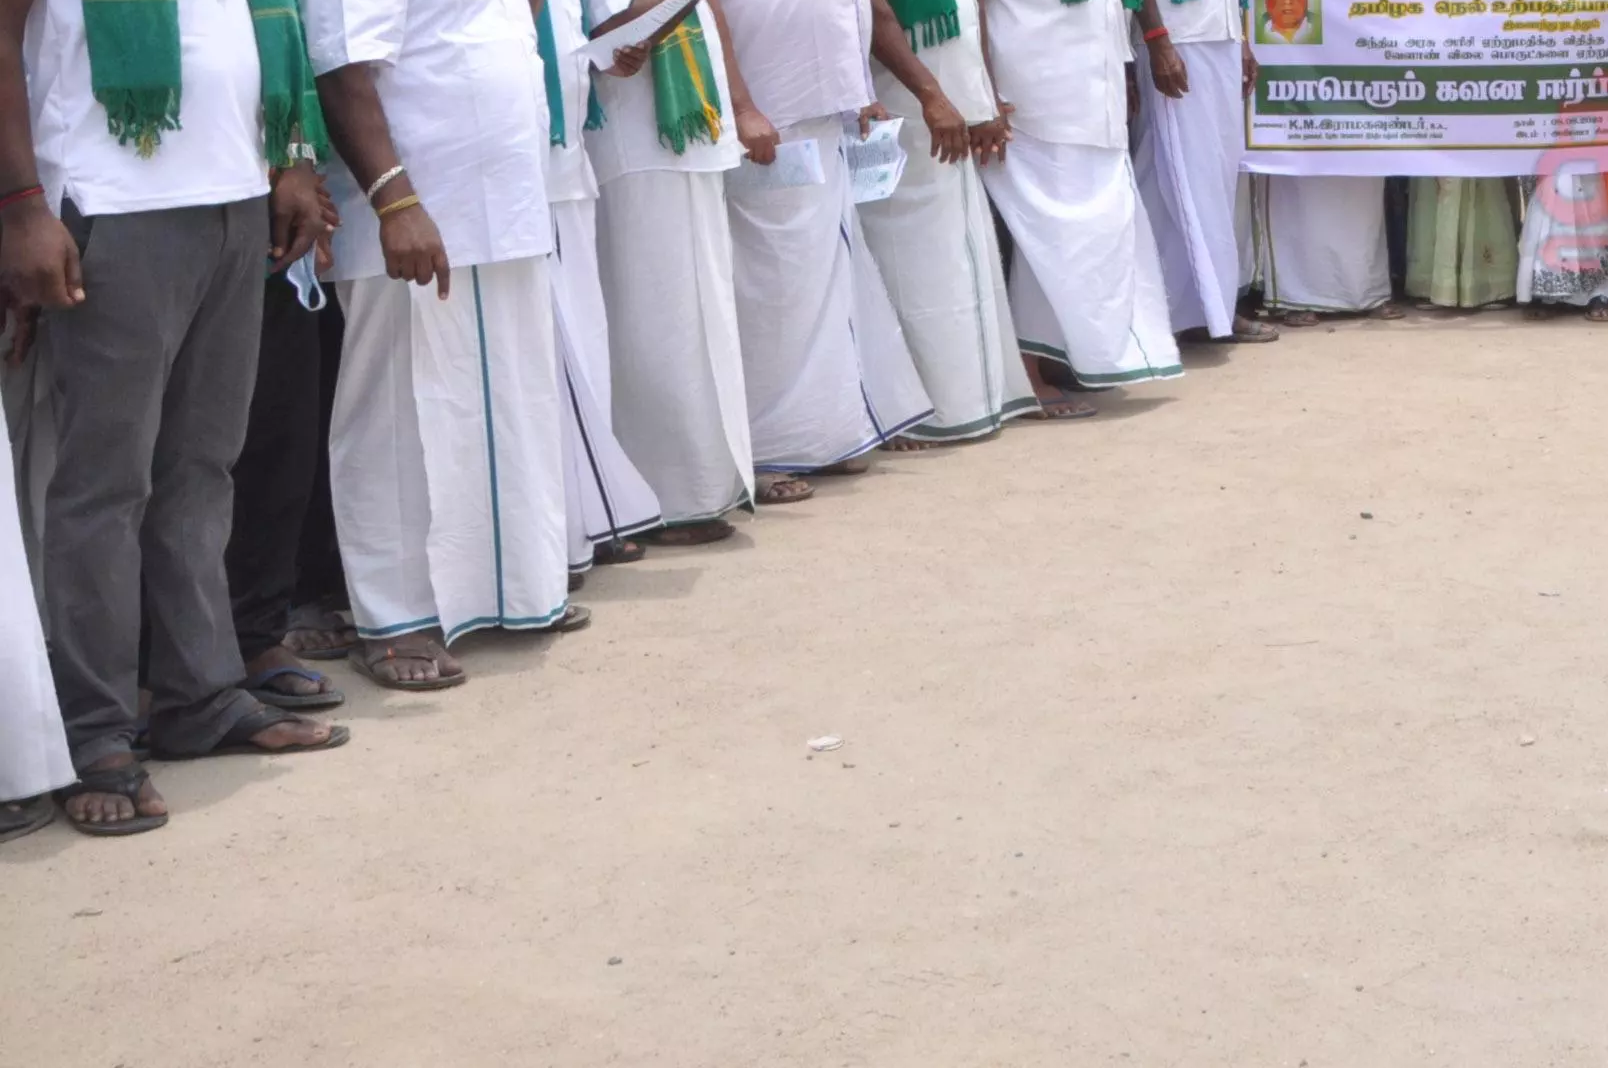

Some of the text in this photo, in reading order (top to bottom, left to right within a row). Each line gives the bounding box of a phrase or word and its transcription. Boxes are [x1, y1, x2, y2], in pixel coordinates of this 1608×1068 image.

[1355, 36, 1399, 50] இந்திய
[1404, 38, 1437, 50] அரசு
[1443, 36, 1475, 48] அரிசி
[1481, 35, 1557, 50] ஏற்றுமதிக்கு
[1564, 34, 1605, 47] விதித்த
[1384, 48, 1441, 61] வேளாண்
[1491, 48, 1569, 62] பொருட்களை
[1267, 70, 1426, 107] மாபெரும்
[1436, 80, 1526, 101] கவன
